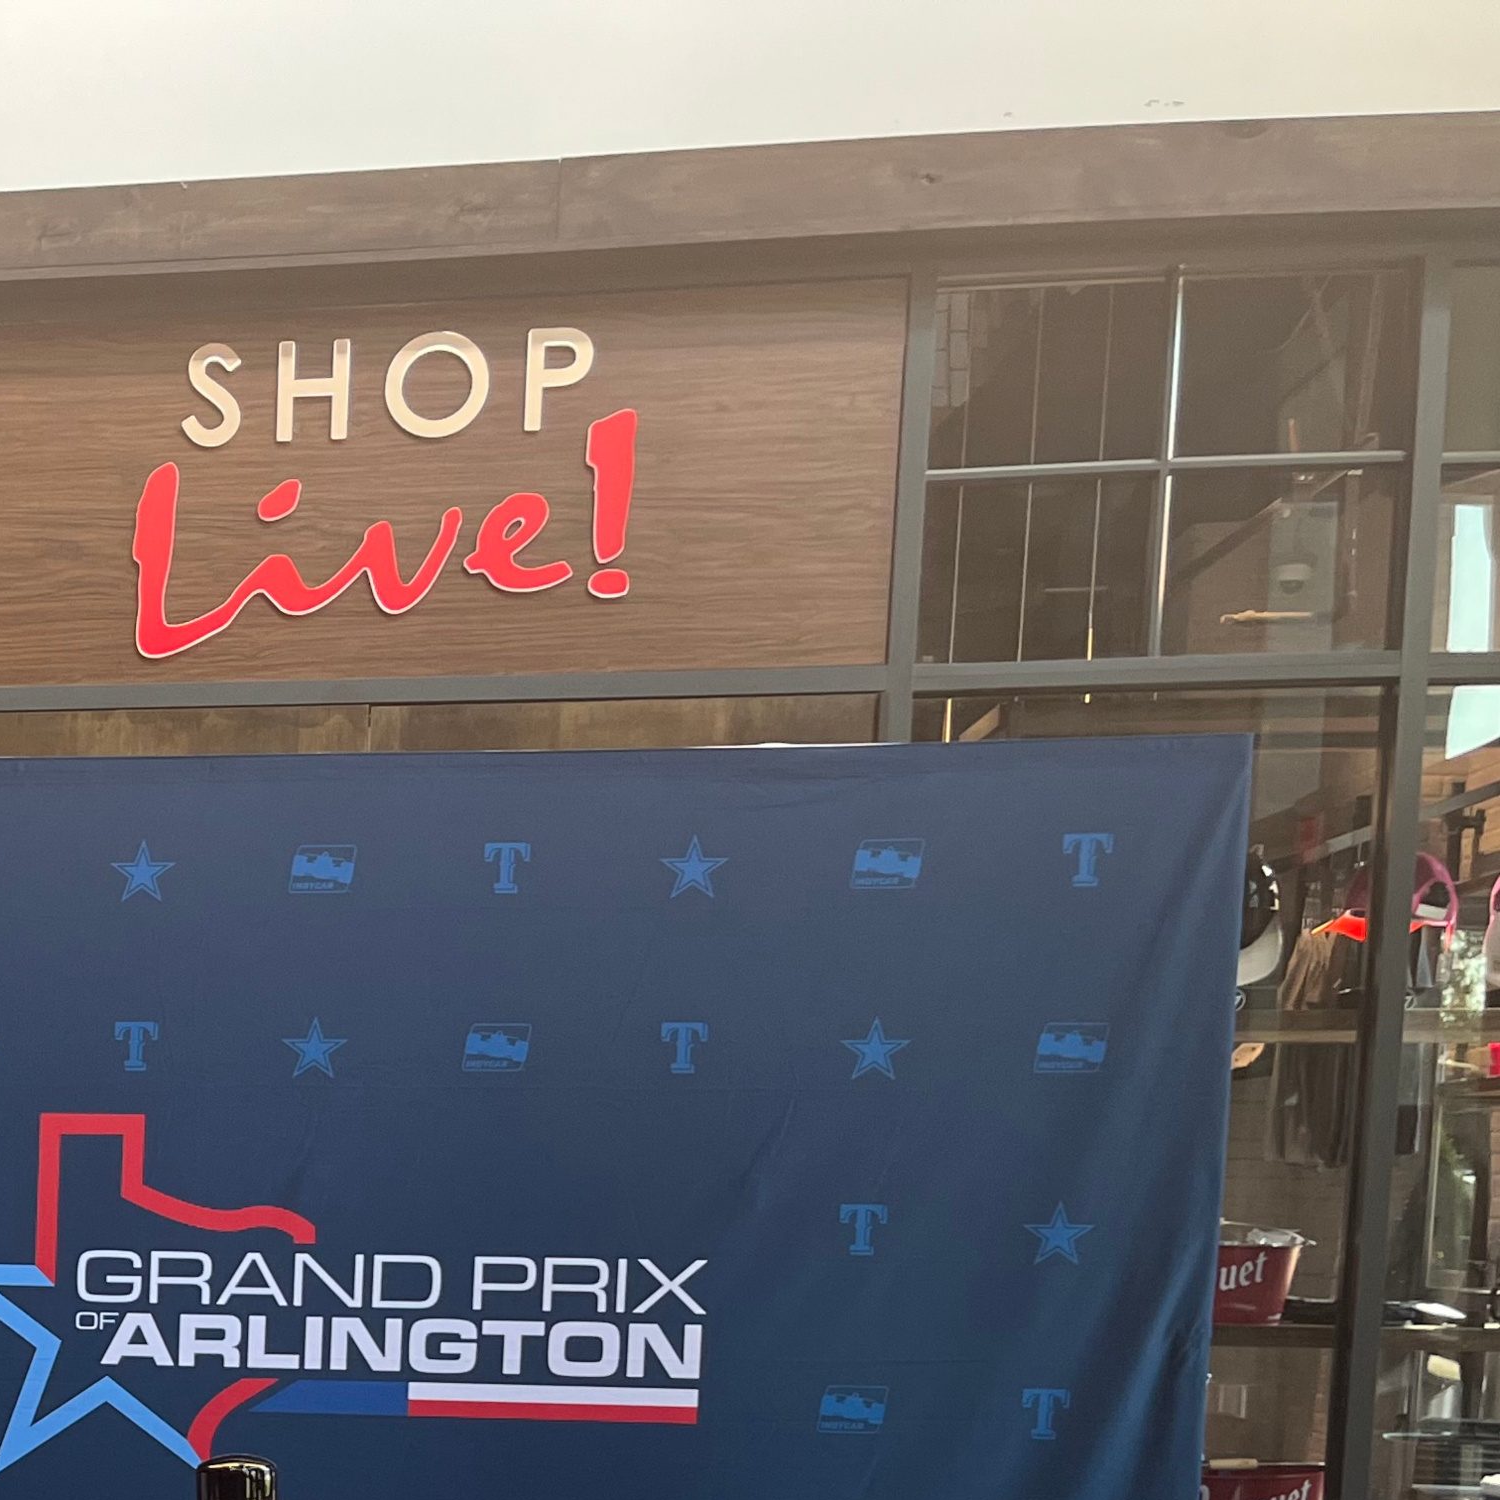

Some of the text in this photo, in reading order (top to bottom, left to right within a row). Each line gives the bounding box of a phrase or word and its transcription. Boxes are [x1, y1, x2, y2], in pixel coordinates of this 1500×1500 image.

[181, 327, 594, 448] SHOP
[132, 408, 638, 659] Live!
[484, 842, 530, 894] T
[1062, 832, 1113, 887] T
[114, 1021, 159, 1071] T
[660, 1021, 709, 1074] T
[839, 1203, 888, 1256] T
[75, 1249, 708, 1316] GRAND PRIX
[75, 1311, 703, 1379] OF ARLINGTON
[1021, 1387, 1069, 1440] T
